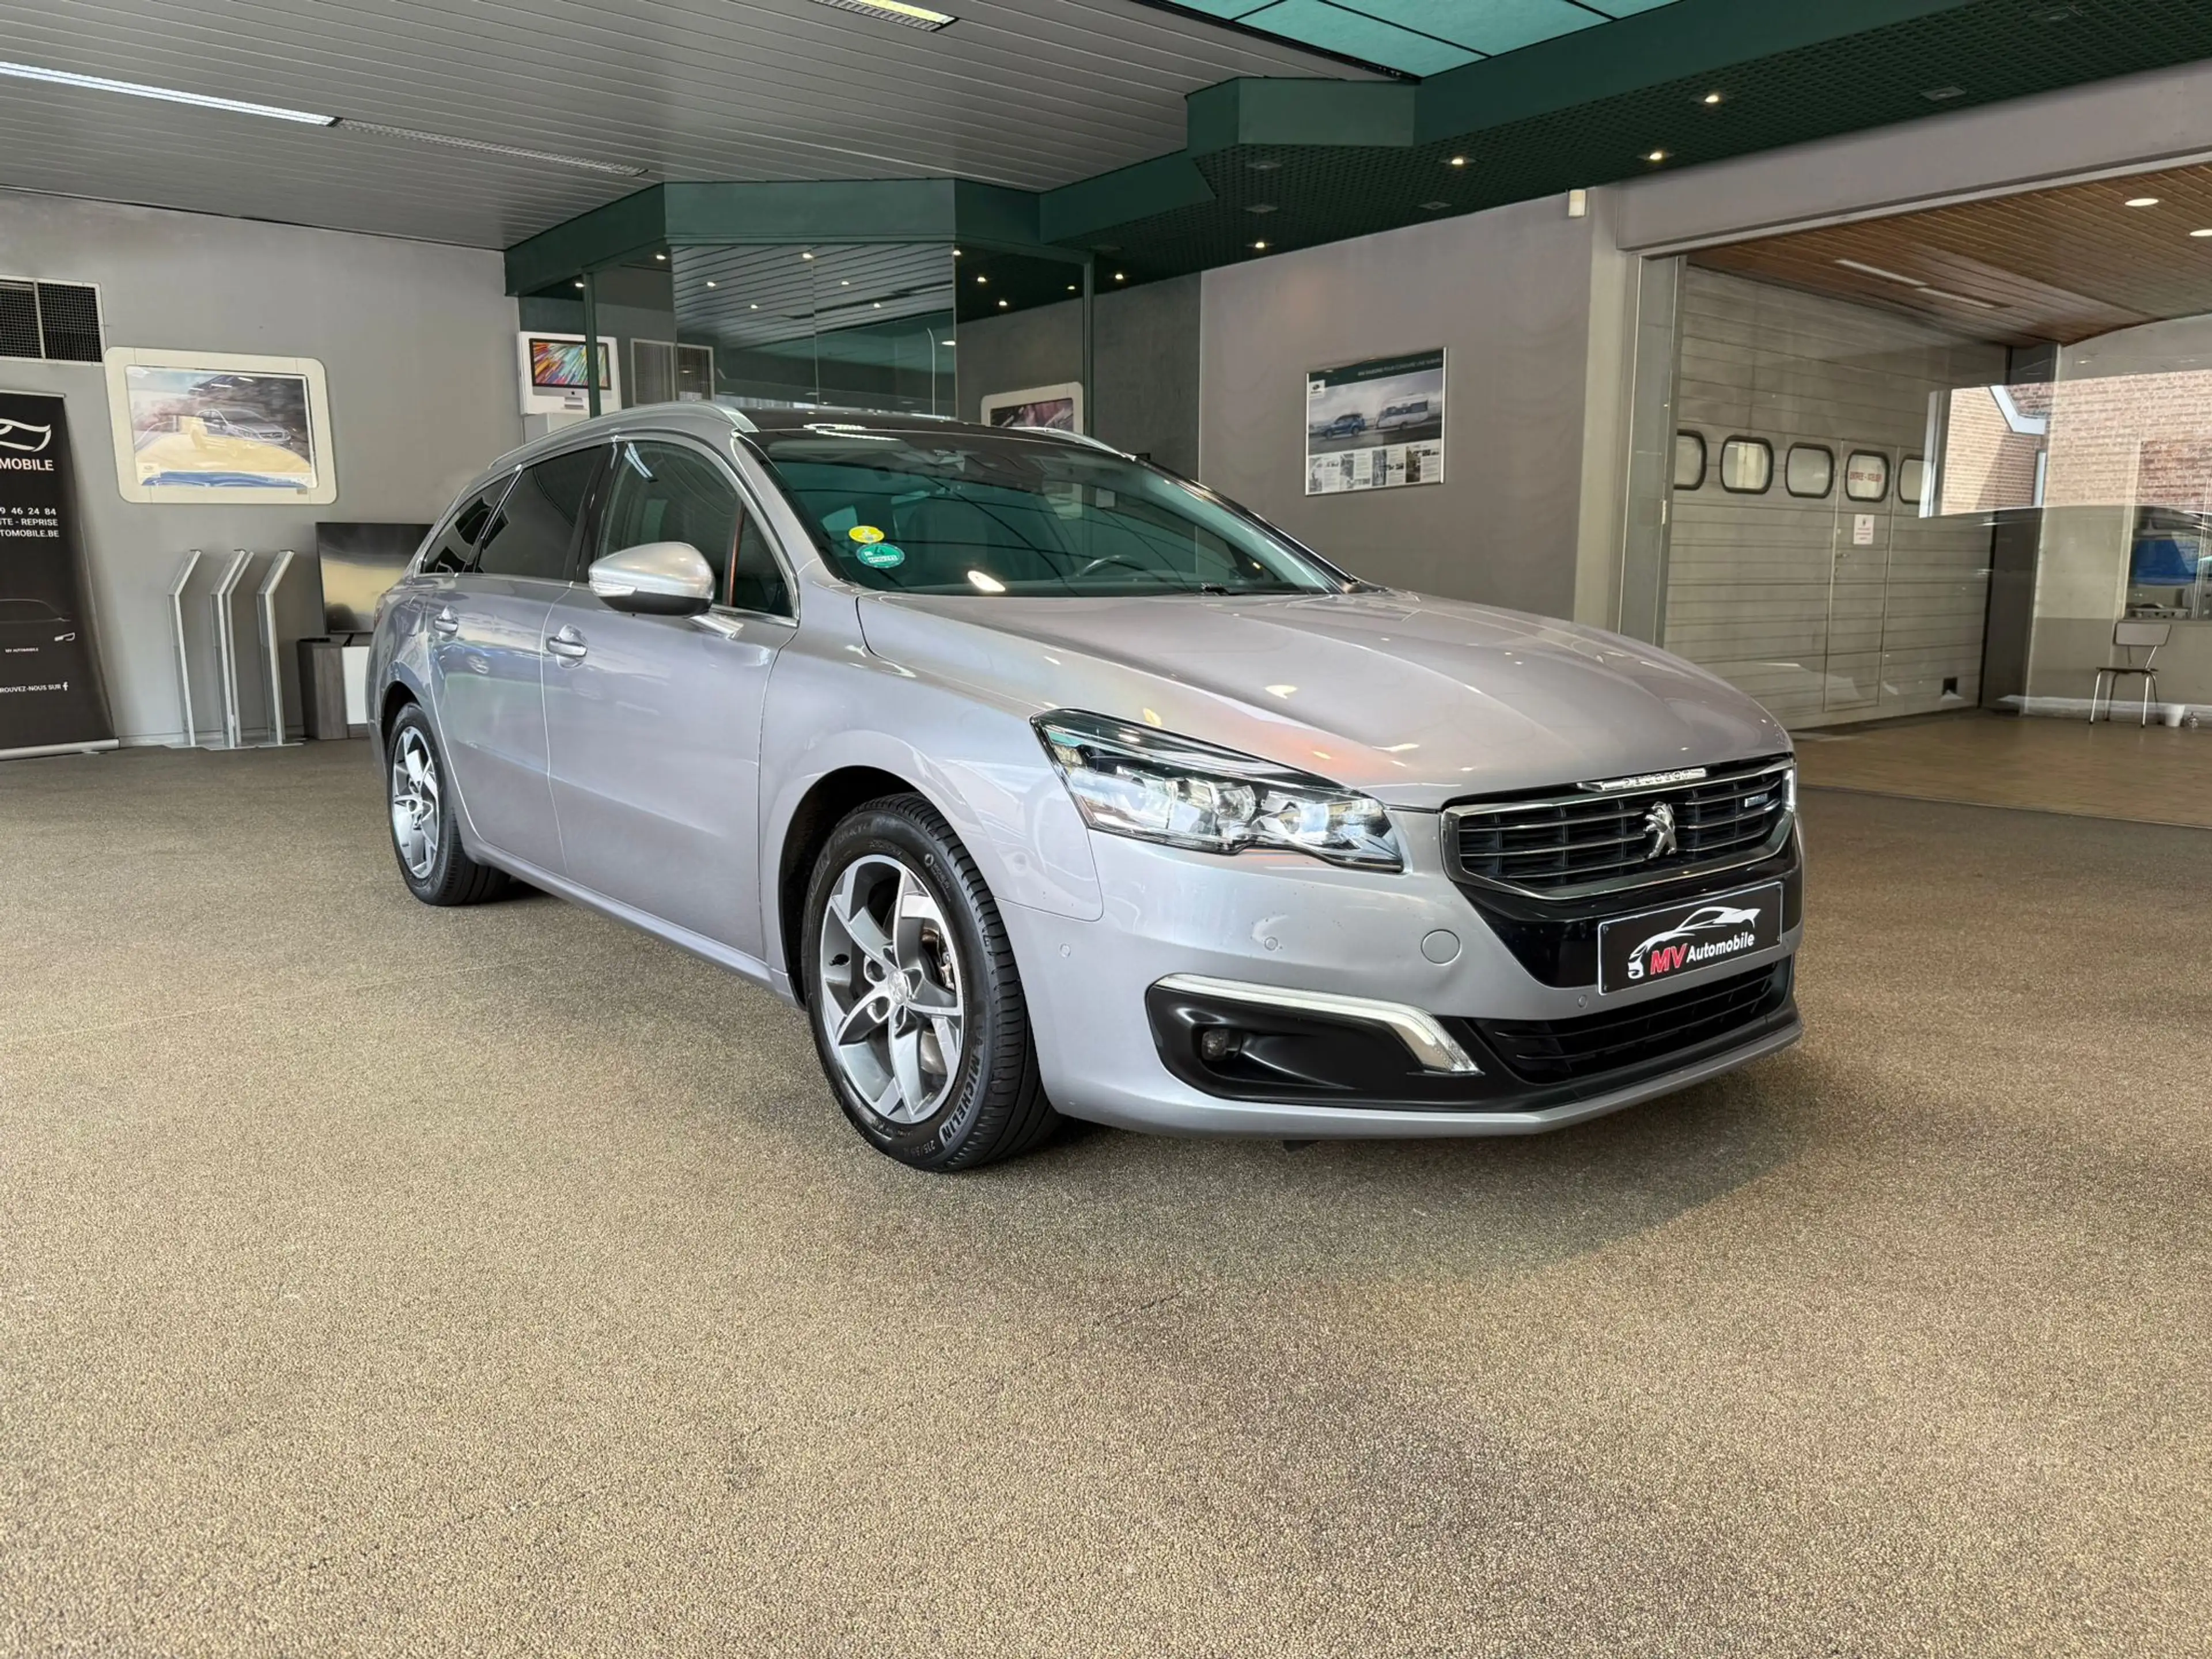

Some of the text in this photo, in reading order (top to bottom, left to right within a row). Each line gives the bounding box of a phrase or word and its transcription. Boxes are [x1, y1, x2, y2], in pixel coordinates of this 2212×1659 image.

[44, 507, 56, 516] 84
[1650, 932, 1755, 975] MV Automobile
[941, 1054, 980, 1142] MICHELIN
